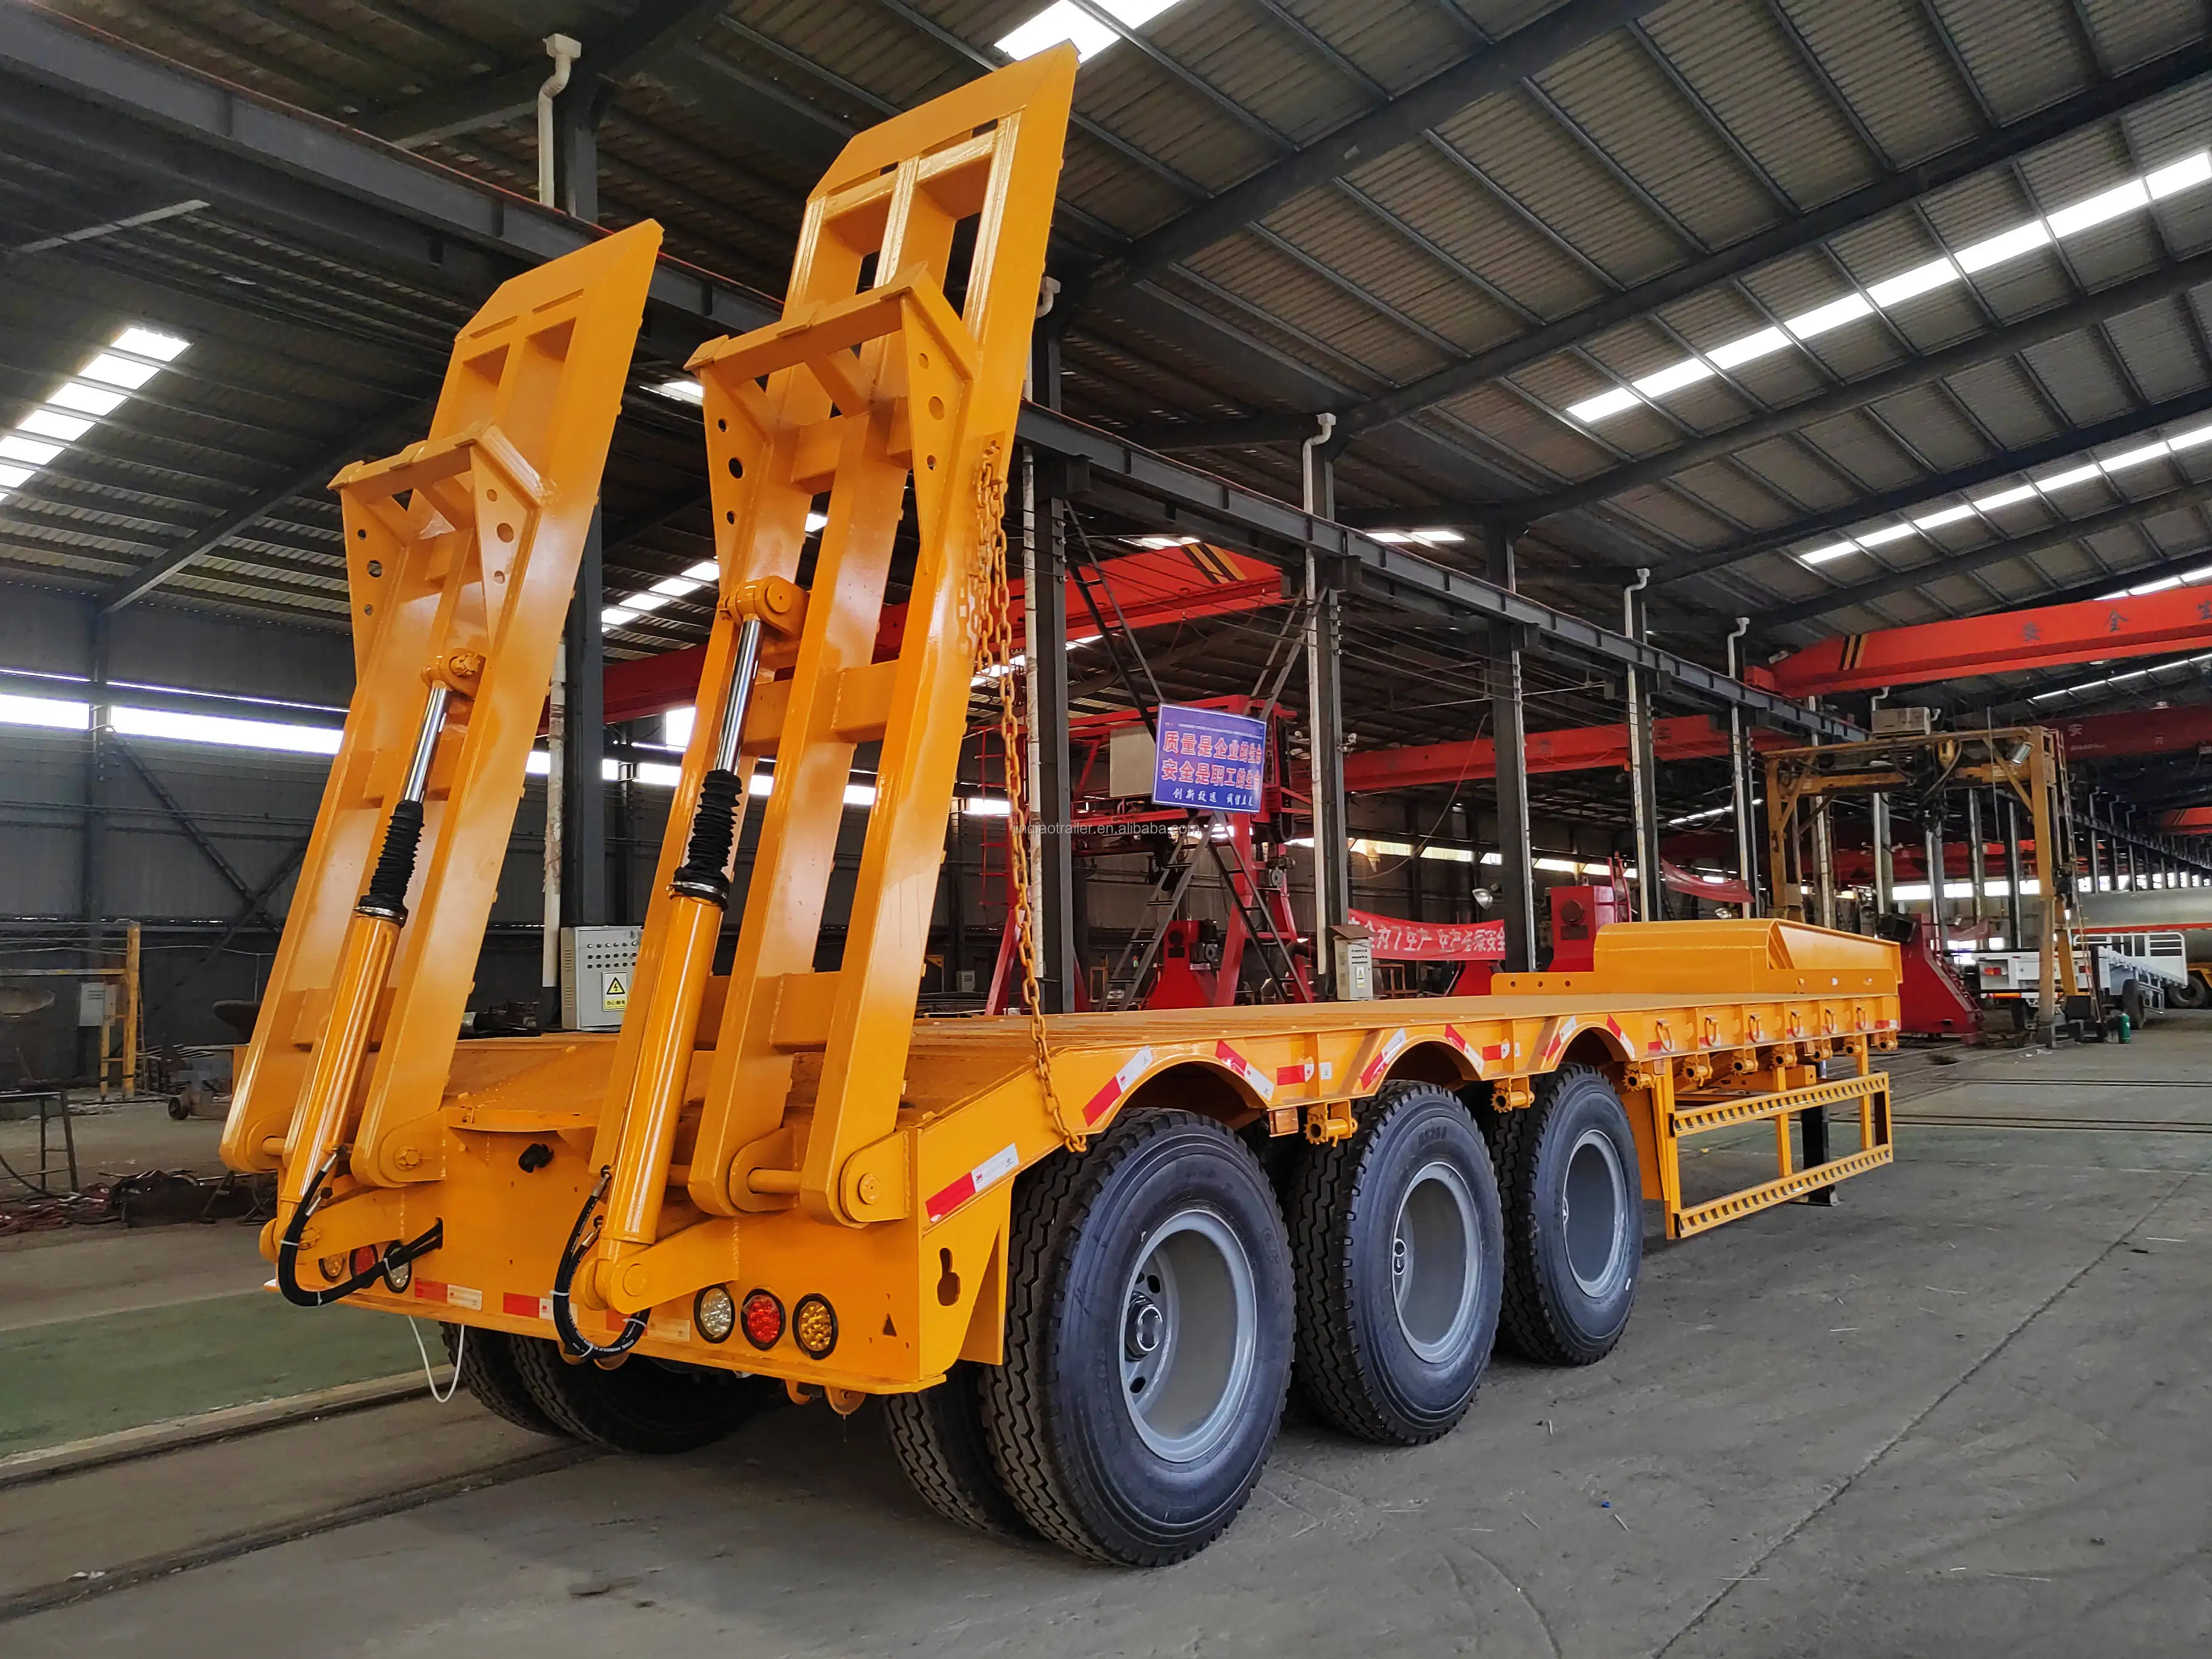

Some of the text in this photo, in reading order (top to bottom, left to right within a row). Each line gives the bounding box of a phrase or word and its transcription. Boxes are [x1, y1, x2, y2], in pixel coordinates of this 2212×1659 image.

[1162, 730, 1262, 765] 质量是企业的生命
